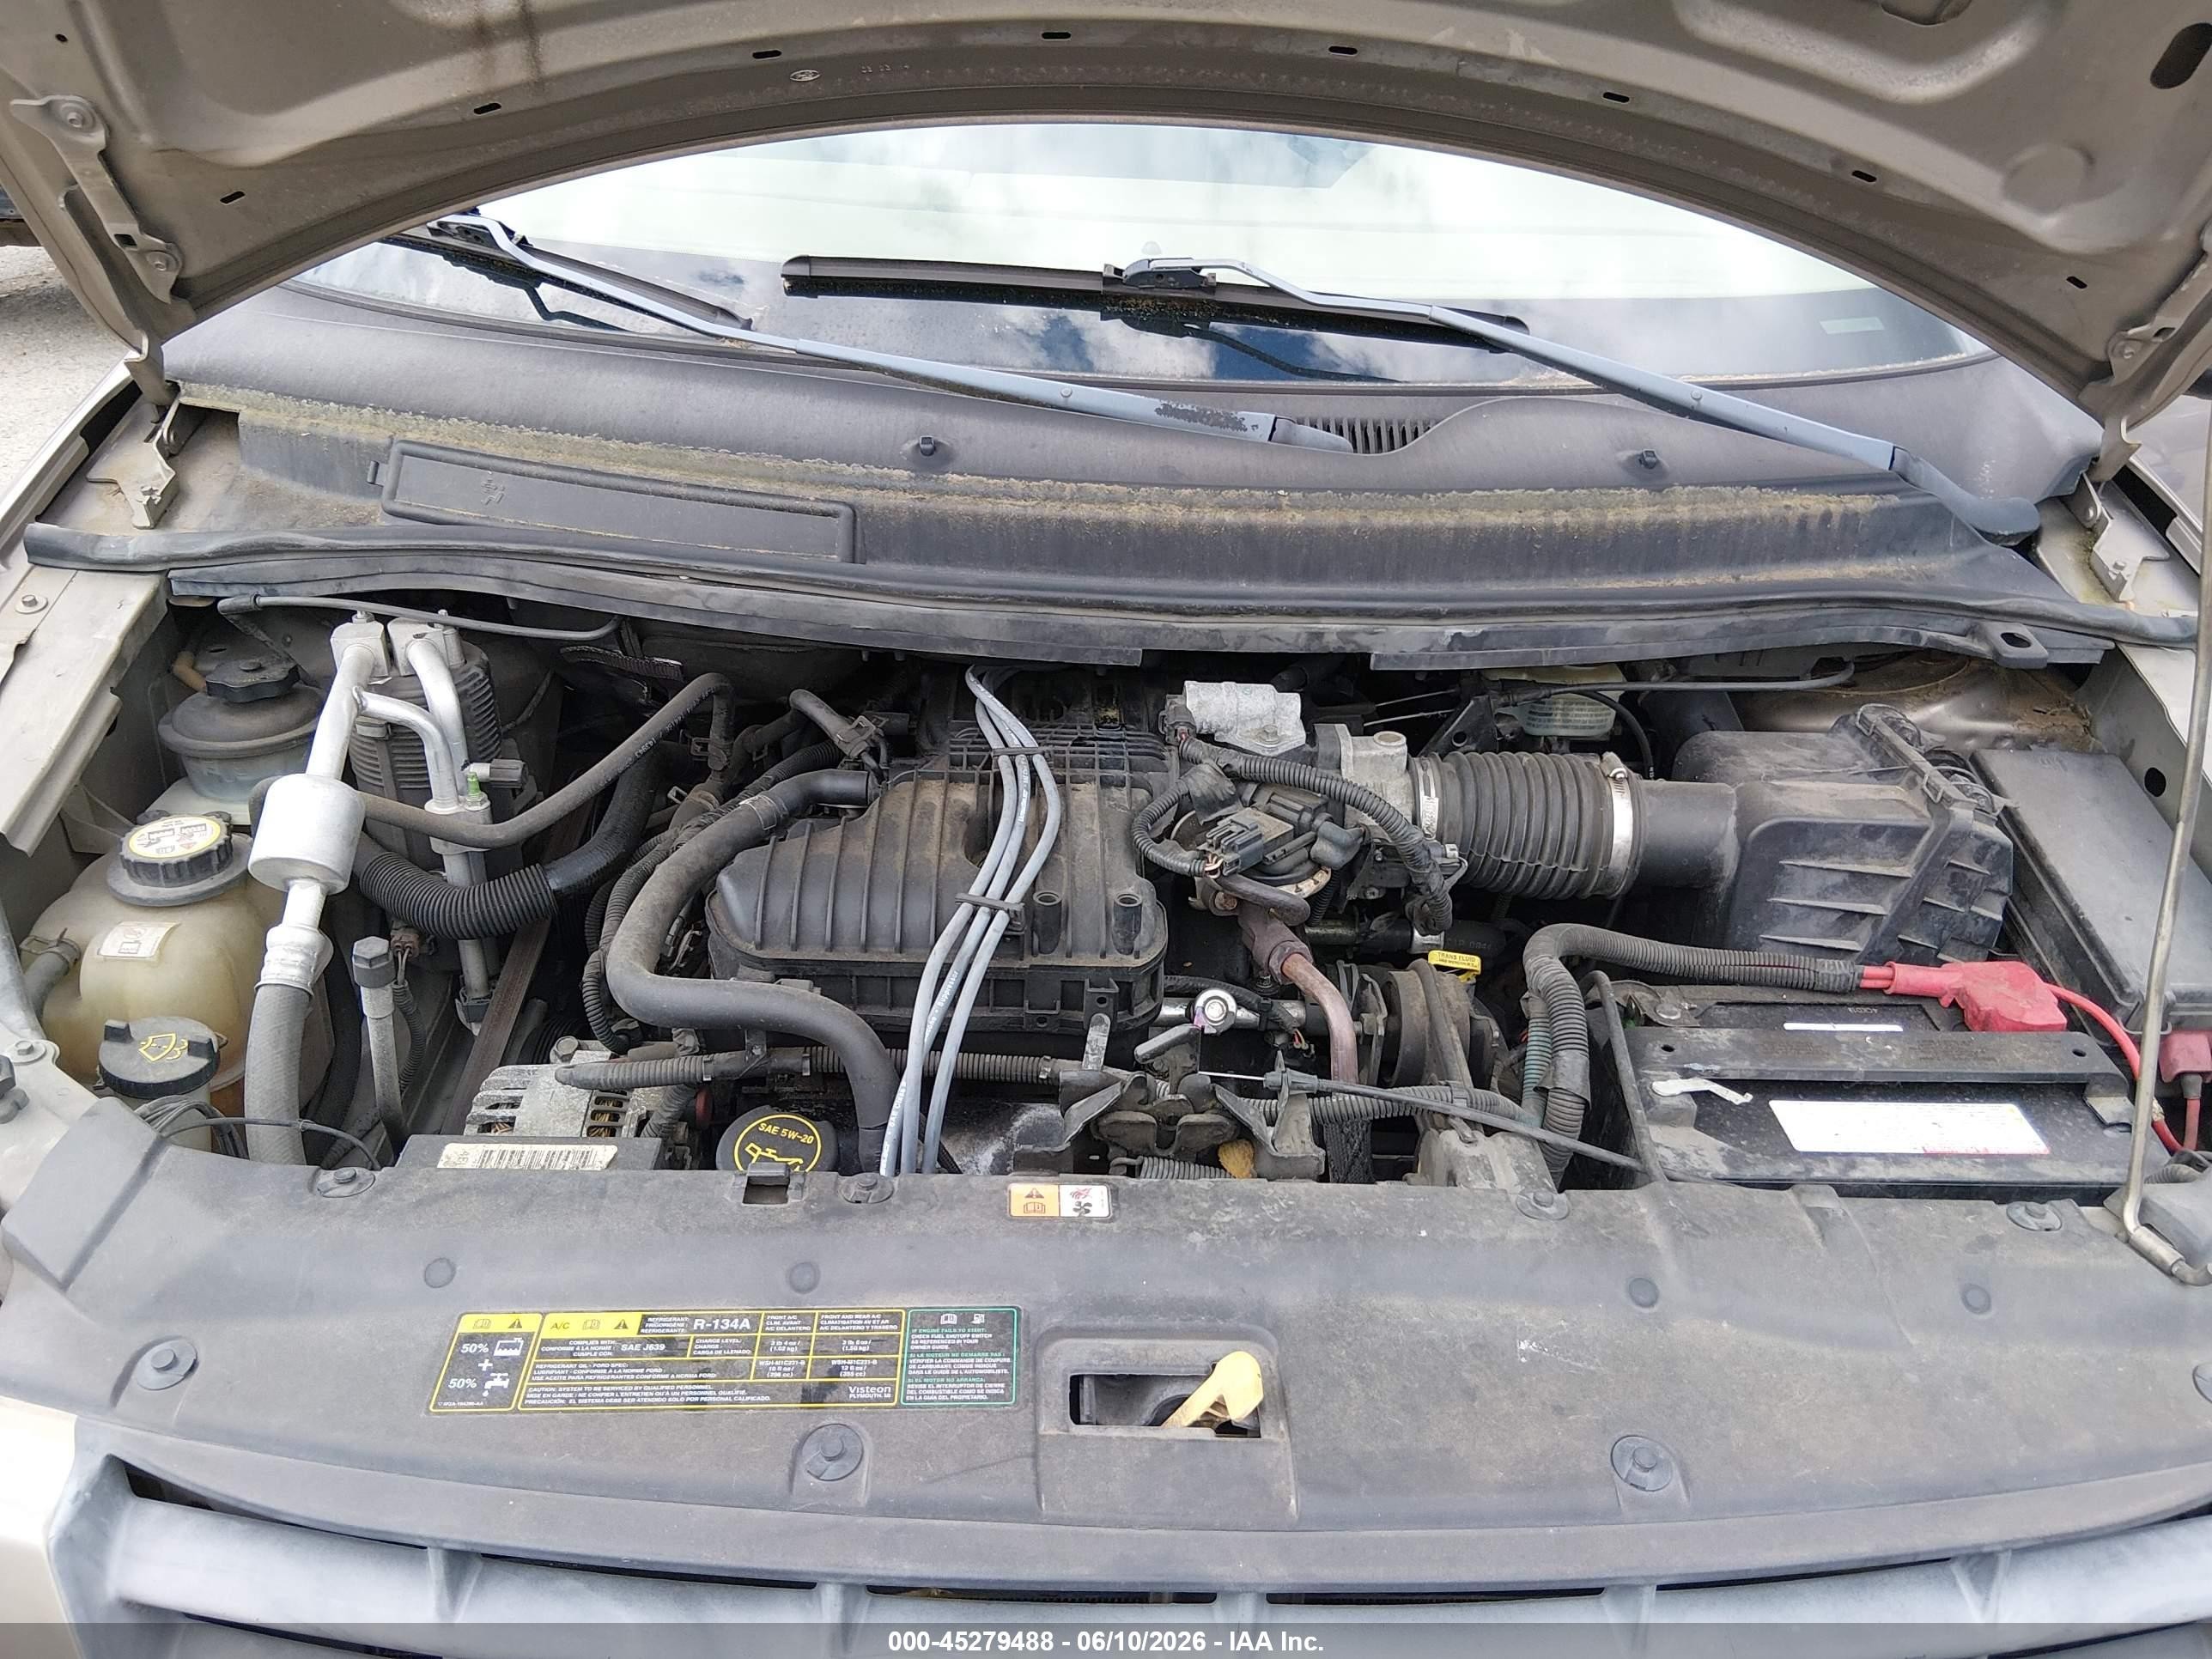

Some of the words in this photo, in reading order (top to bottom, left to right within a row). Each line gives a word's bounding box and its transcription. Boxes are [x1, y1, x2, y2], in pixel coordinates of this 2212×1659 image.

[1459, 954, 1476, 963] FLUID
[758, 1122, 781, 1135] SAE
[781, 1127, 815, 1145] 5W-20
[550, 1322, 570, 1330] A/C
[693, 1318, 750, 1331] R-134A
[460, 1342, 489, 1353] 50%
[448, 1378, 477, 1389] 50%
